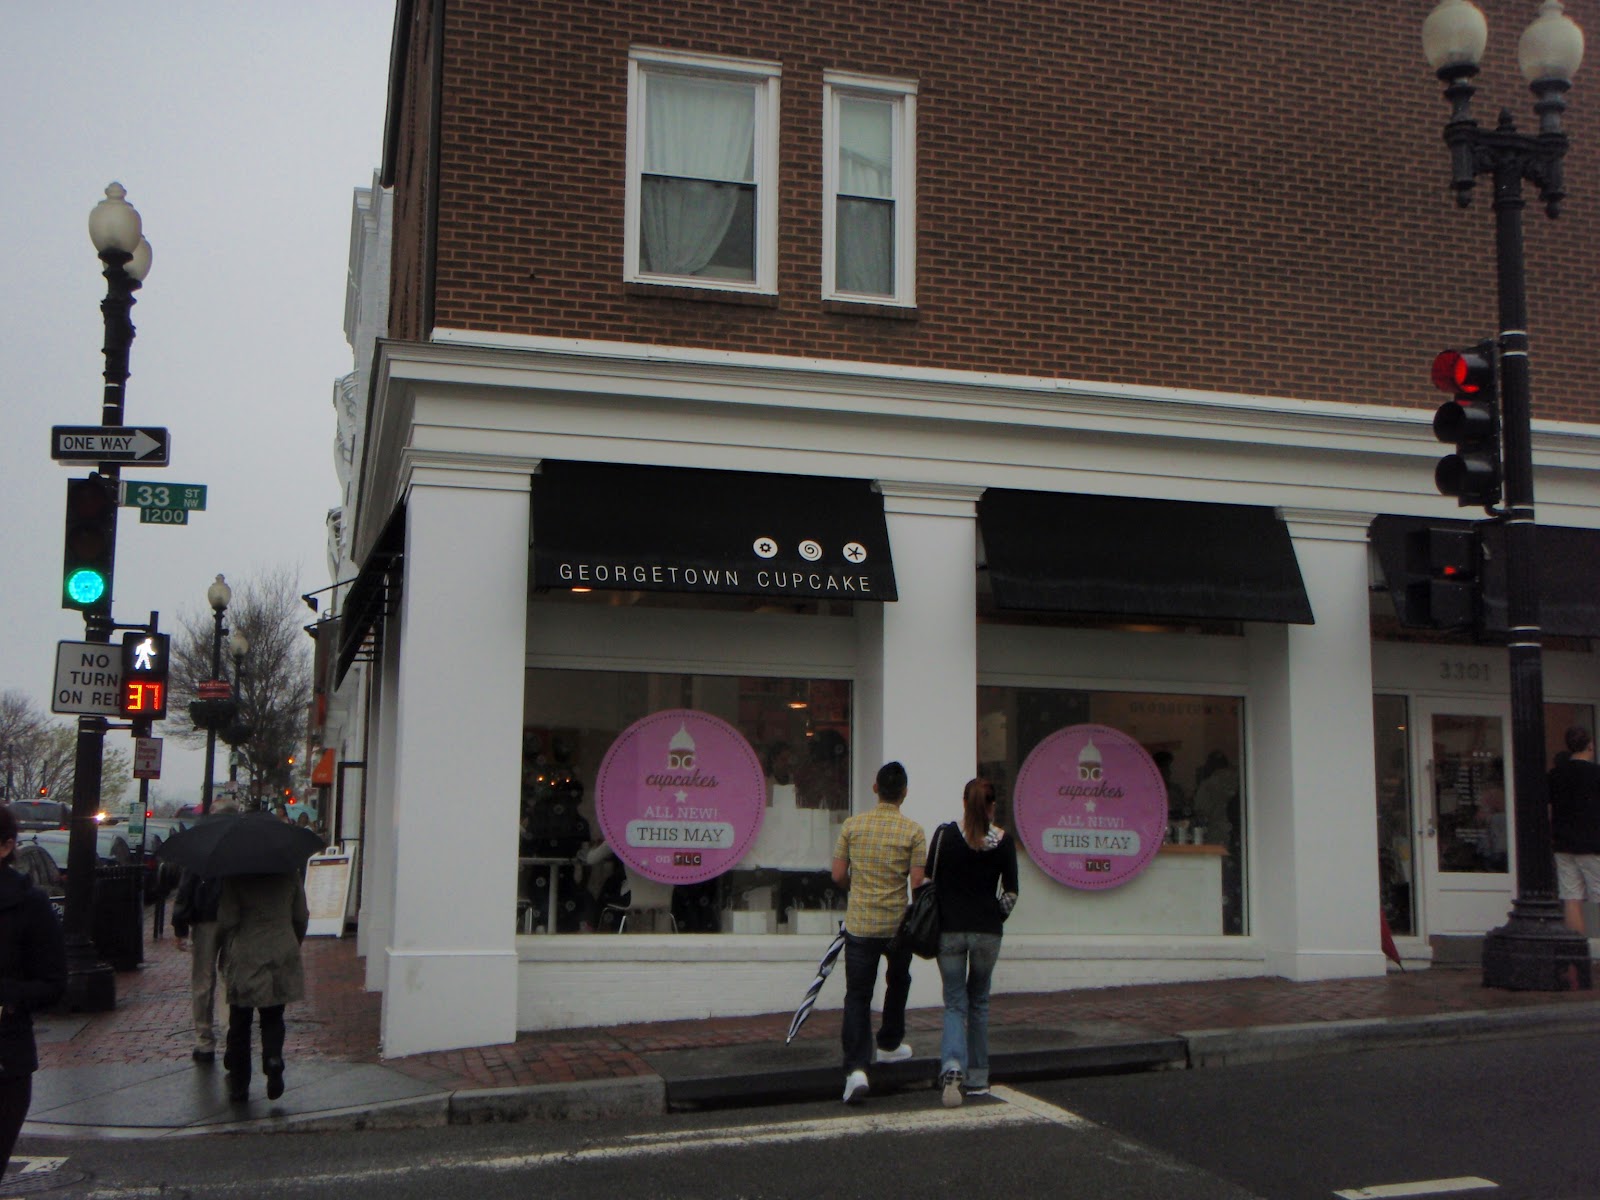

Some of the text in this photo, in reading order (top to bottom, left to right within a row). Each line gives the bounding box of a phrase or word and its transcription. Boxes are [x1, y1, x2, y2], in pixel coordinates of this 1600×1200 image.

[63, 436, 133, 451] ONE WAY
[137, 485, 200, 507] 33 ST
[183, 499, 199, 508] NW
[145, 509, 184, 523] 1200
[559, 563, 872, 592] GEORGETOWN CUPCAKE
[81, 653, 110, 668] NO
[70, 670, 119, 688] TURN
[1439, 661, 1491, 682] 3301
[59, 689, 83, 705] ON
[127, 684, 160, 710] 37
[666, 754, 696, 770] DC
[645, 768, 719, 791] cupcakes
[1077, 766, 1104, 781] DC
[1058, 780, 1124, 802] cupcakes
[644, 806, 718, 819] ALL NEW!
[1057, 816, 1124, 828] ALL NEW!
[637, 827, 724, 842] THIS MAY
[1052, 834, 1131, 849] THIS MAY
[655, 853, 701, 866] on TLC
[1086, 860, 1111, 872] TLC
